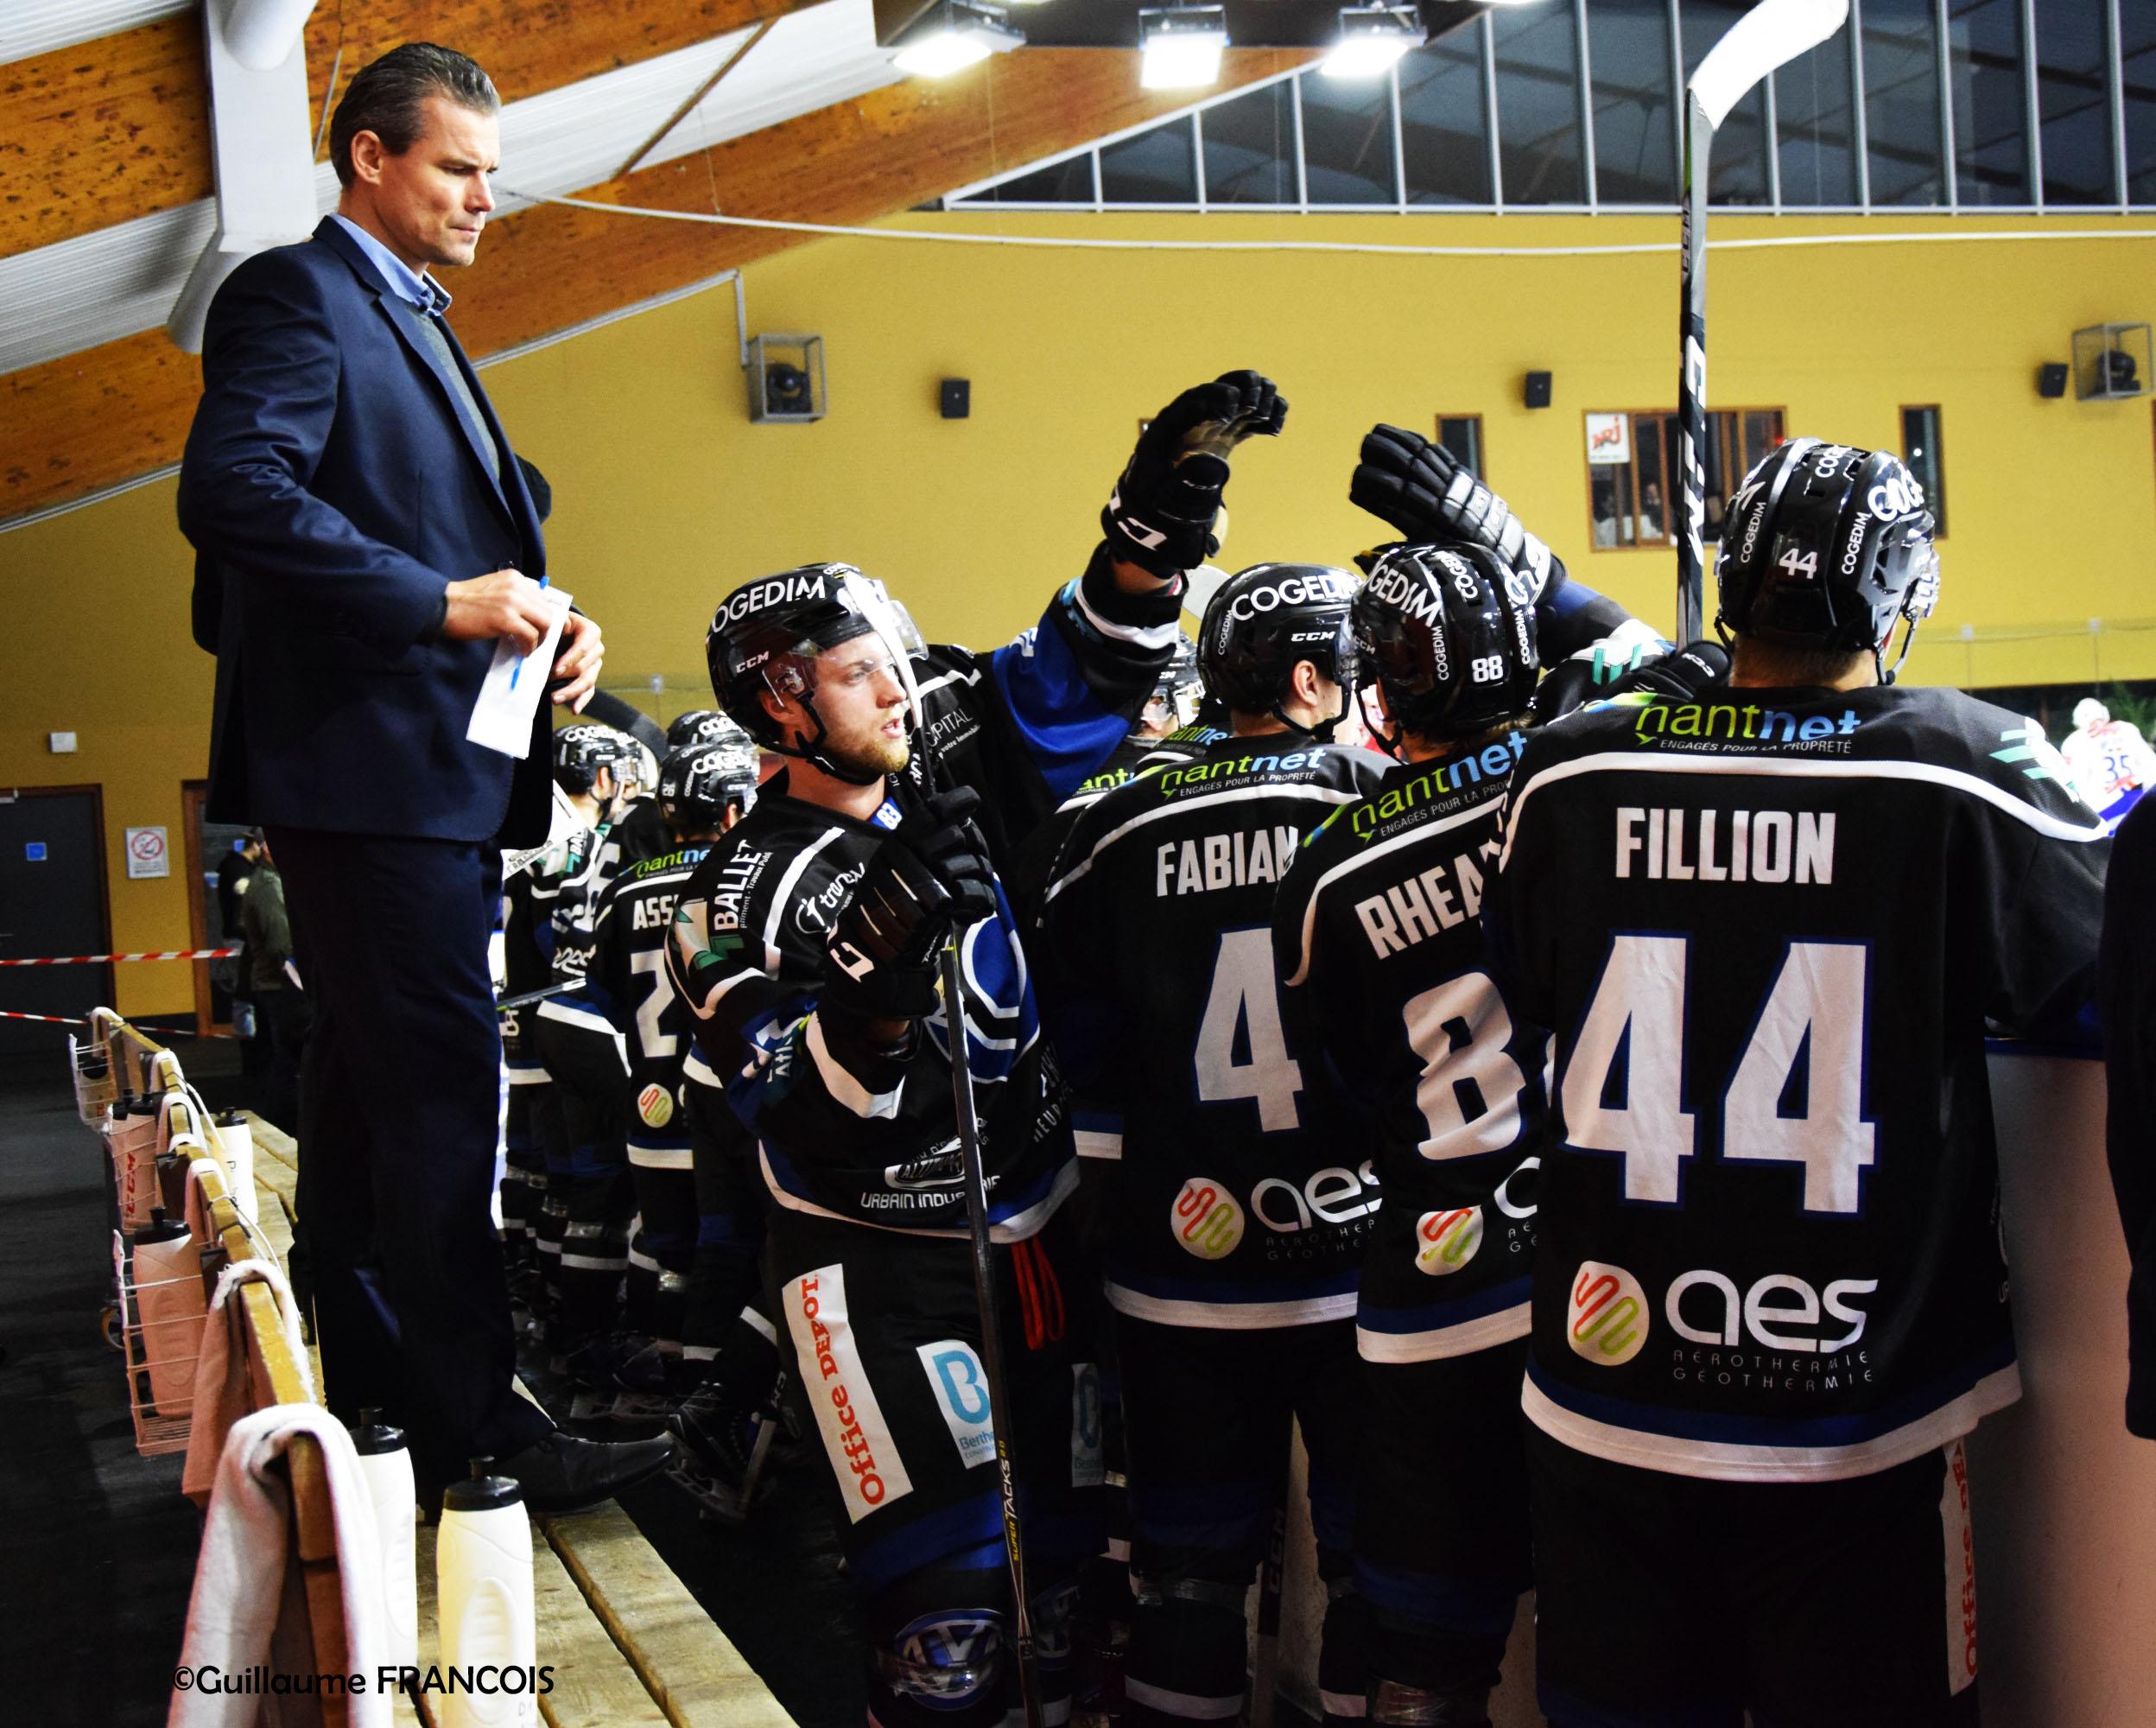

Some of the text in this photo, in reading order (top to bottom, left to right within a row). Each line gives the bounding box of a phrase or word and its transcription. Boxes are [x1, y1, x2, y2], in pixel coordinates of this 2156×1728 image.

[1741, 501, 1766, 564] COGEDIM
[1842, 511, 1873, 575] COGEDIM
[1779, 548, 1817, 580] 44
[1216, 608, 1235, 656] COGEDIM
[1290, 630, 1336, 643] CCM
[1430, 625, 1450, 682] COGEDIM
[1512, 608, 1531, 665] COGEDIM
[736, 651, 770, 674] CCM
[1471, 655, 1503, 683] 88
[1635, 704, 1861, 743] nantnet
[1161, 748, 1326, 791] nantnet
[1226, 776, 1250, 787] POUR
[1252, 774, 1265, 783] LA
[1352, 730, 1527, 835] nantnet
[875, 802, 903, 830] 83
[1430, 796, 1461, 816] POUR
[1463, 790, 1480, 804] LA
[1615, 807, 1836, 884] FILLION
[632, 893, 680, 931] ASS
[713, 839, 762, 931] BALLET
[1354, 841, 1500, 960] RHEA
[1194, 927, 1303, 1133] 4
[1402, 971, 1555, 1160] 8
[1562, 935, 1876, 1213] 44
[860, 1191, 916, 1210] URBAIN
[1251, 1159, 1382, 1233] aes
[1665, 1269, 1878, 1353] aes
[831, 1382, 886, 1506] Office
[1001, 1460, 1015, 1519] TACKS
